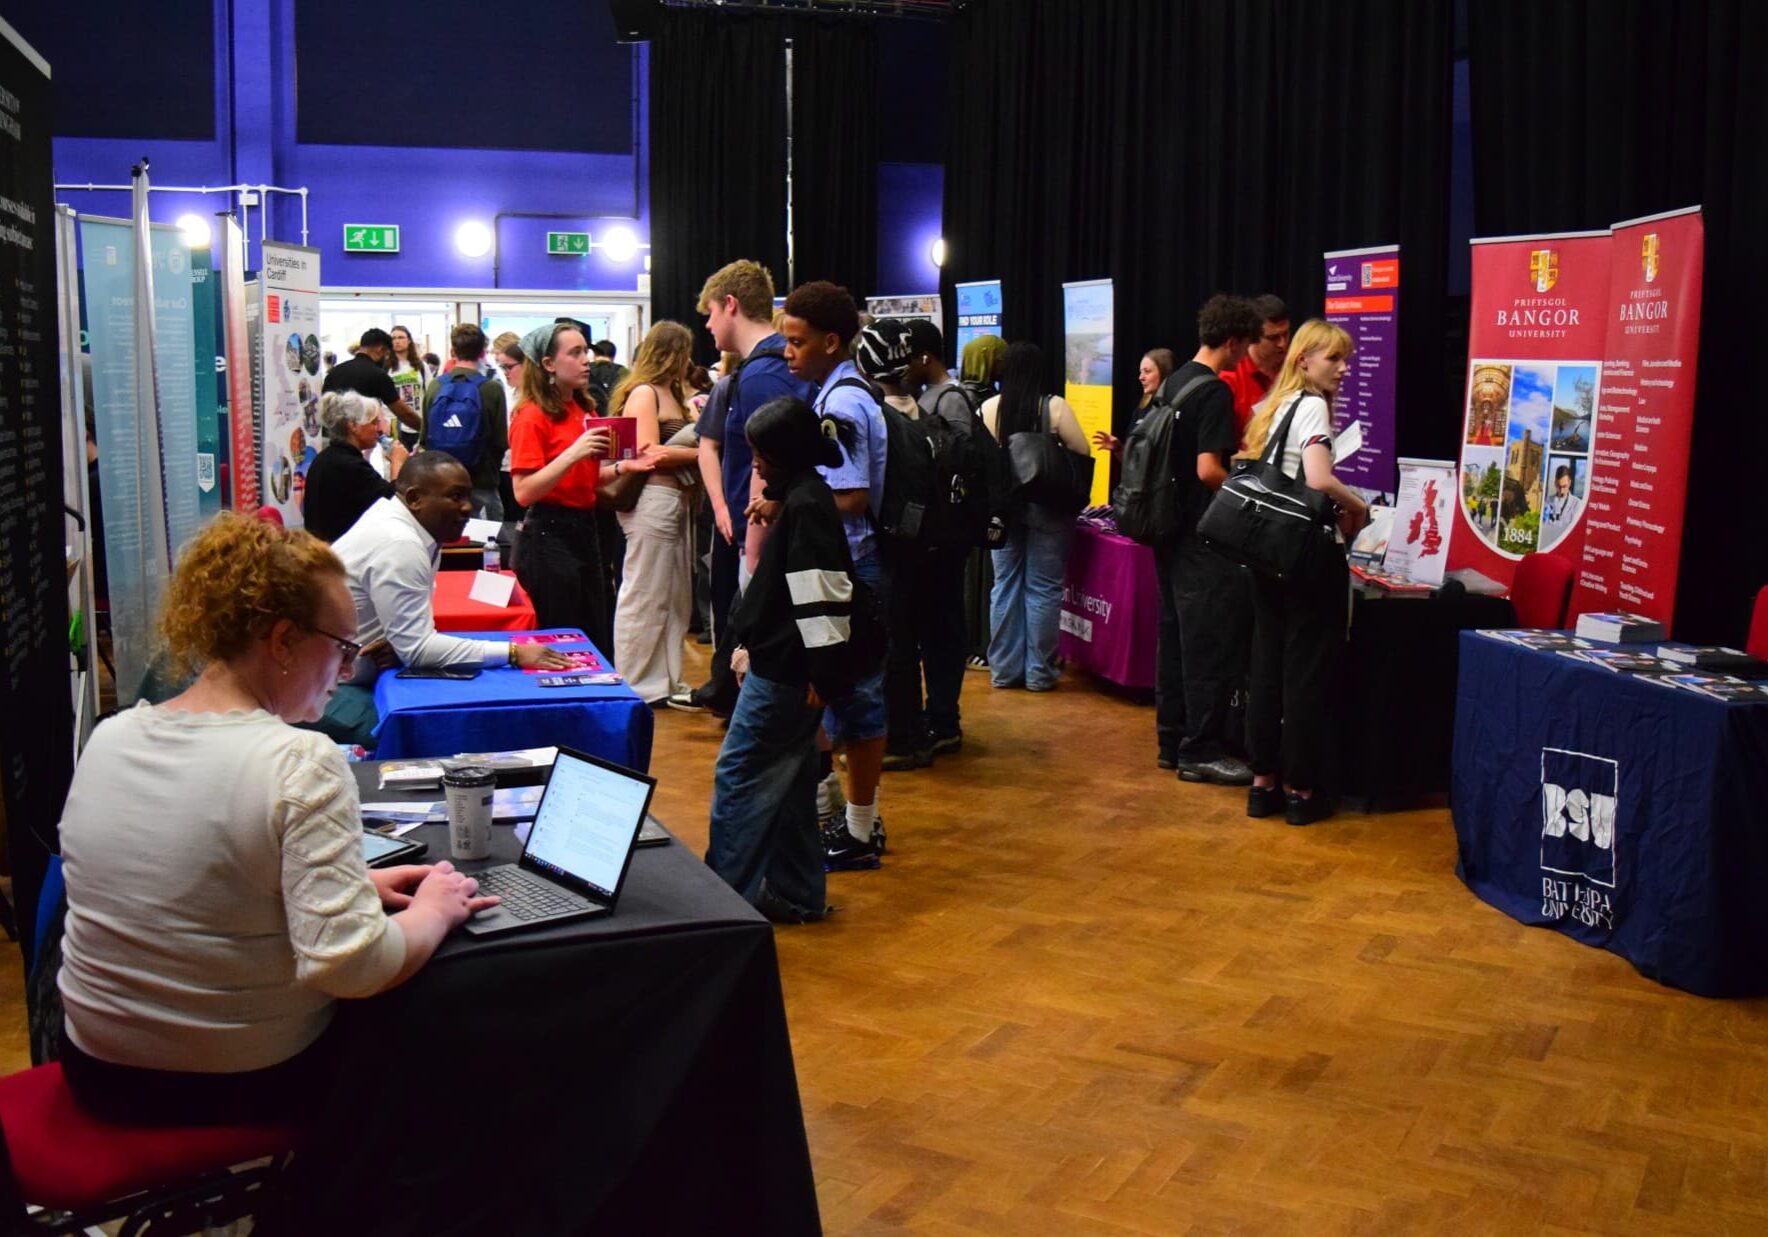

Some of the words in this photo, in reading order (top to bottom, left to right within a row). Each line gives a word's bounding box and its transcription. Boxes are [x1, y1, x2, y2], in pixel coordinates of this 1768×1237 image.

[266, 252, 300, 269] Universities
[301, 260, 307, 270] in
[266, 267, 287, 281] Cardiff
[1496, 309, 1580, 326] BANGOR
[1619, 300, 1668, 321] BANGOR
[1508, 329, 1567, 338] UNIVERSITY
[1503, 527, 1533, 545] 1884
